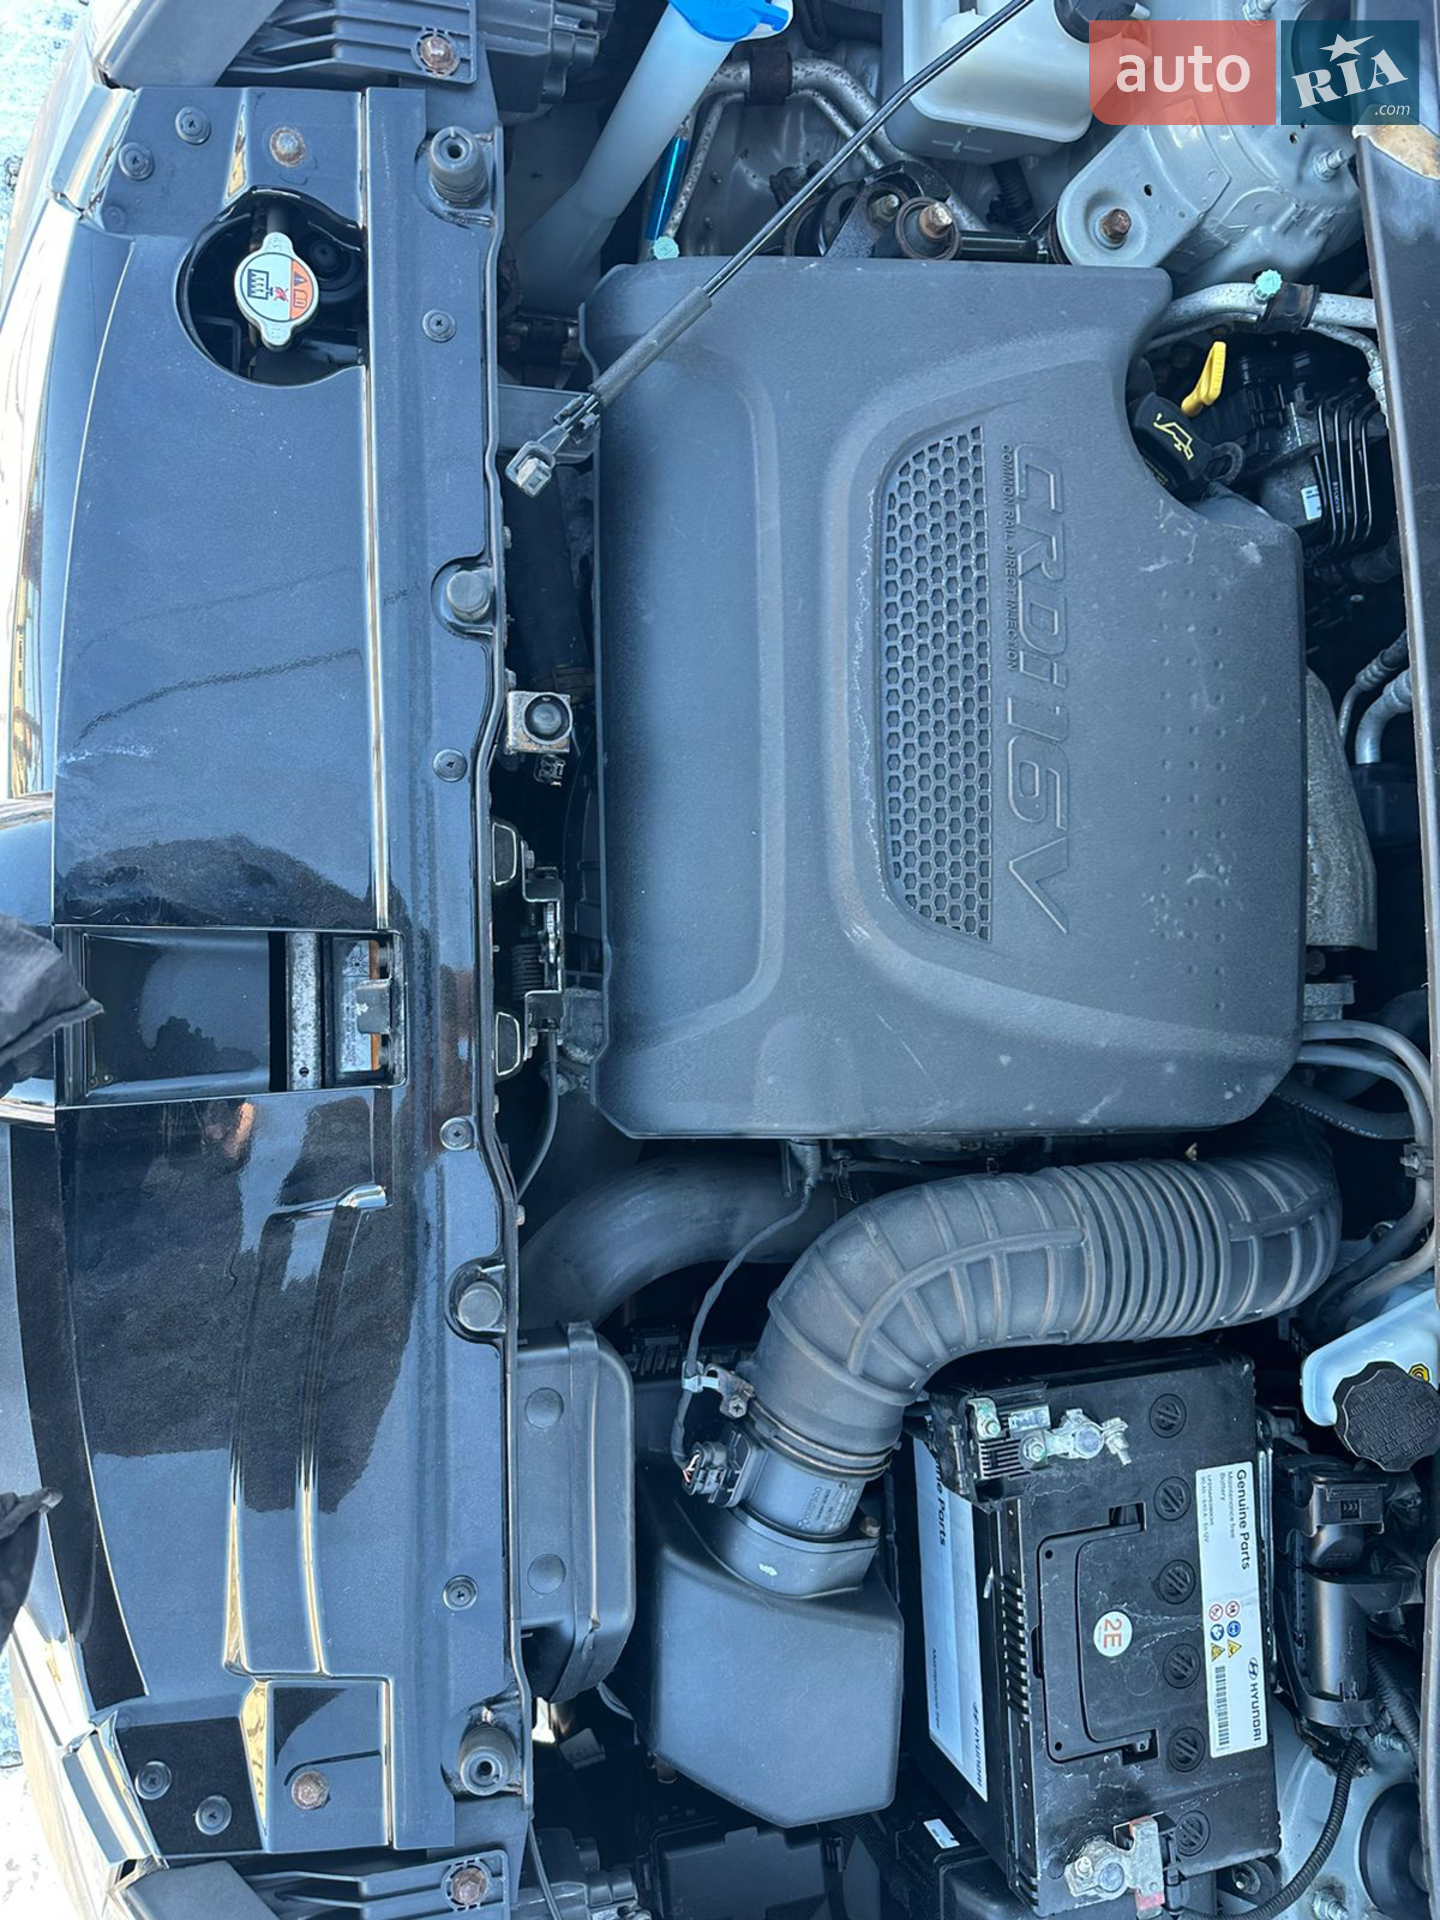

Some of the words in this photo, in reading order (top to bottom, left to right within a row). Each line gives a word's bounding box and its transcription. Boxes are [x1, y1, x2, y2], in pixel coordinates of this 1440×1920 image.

[1001, 443, 1015, 505] COMMON
[1003, 510, 1016, 540] RAIL
[1004, 544, 1017, 596] DIRECT
[1014, 444, 1069, 688] CRDi
[1005, 599, 1019, 672] INJECTION
[1007, 697, 1070, 934] 16V
[1219, 1473, 1227, 1501] Battery
[1227, 1471, 1235, 1521] Maintenance
[1237, 1469, 1250, 1529] Genuine
[937, 1497, 947, 1546] Parts
[1240, 1532, 1251, 1570] Parts
[1103, 1618, 1123, 1649] 2E
[1250, 1683, 1262, 1741] HYUNDAI
[973, 1727, 983, 1787] HYUNDAI
